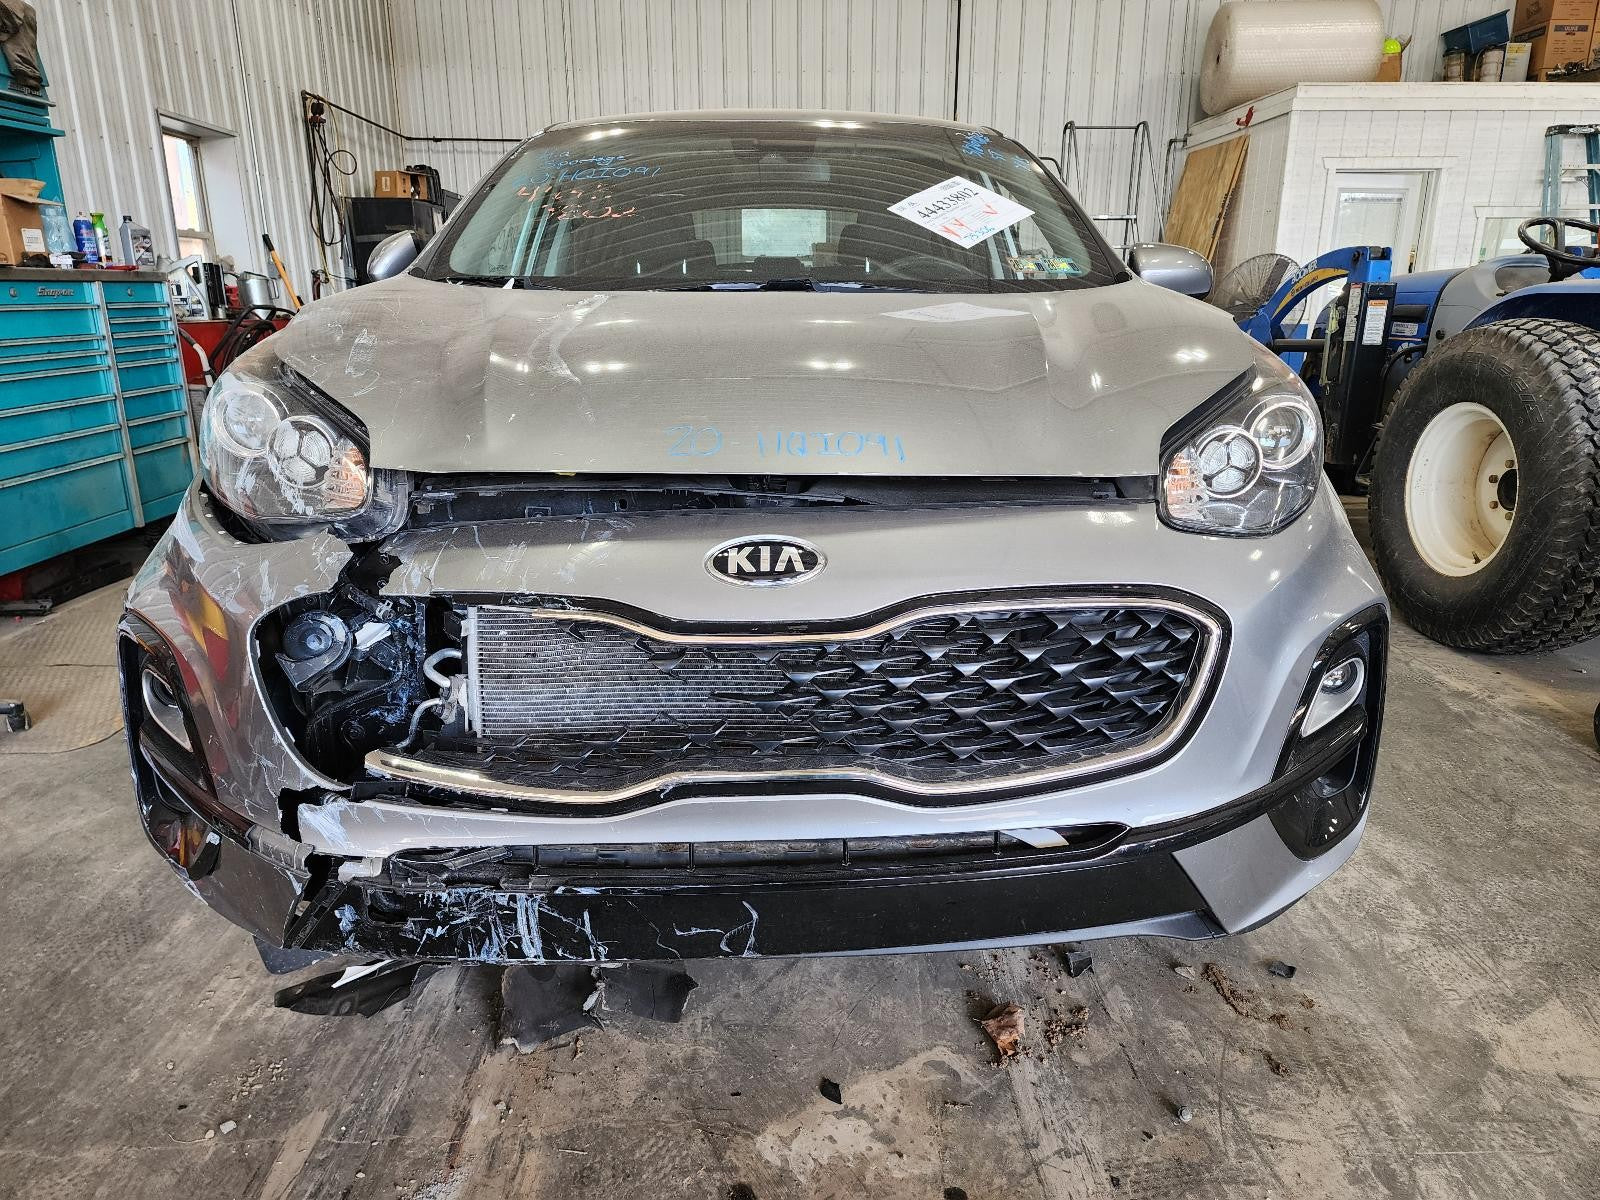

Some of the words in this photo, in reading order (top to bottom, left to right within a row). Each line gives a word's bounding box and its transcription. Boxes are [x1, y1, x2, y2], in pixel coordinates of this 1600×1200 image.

[917, 187, 980, 220] 44433802
[665, 424, 723, 457] 20
[727, 545, 809, 574] KIA
